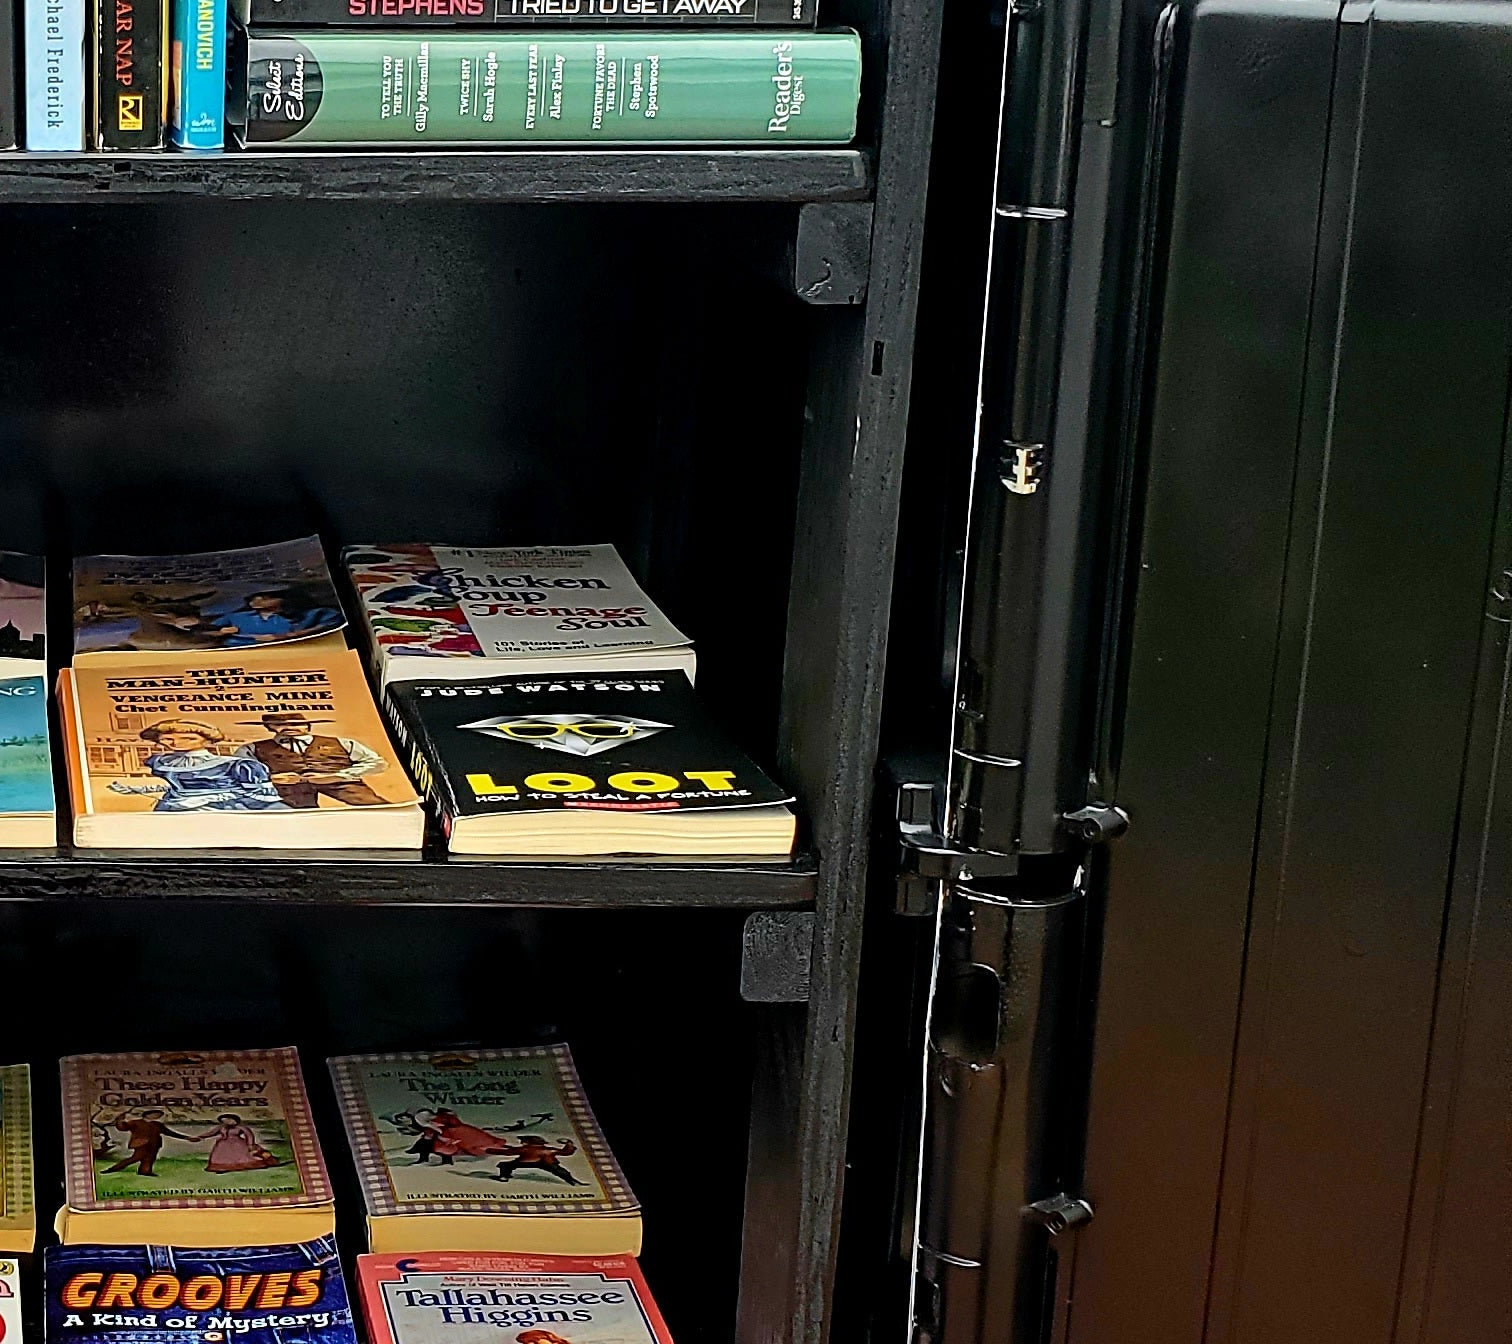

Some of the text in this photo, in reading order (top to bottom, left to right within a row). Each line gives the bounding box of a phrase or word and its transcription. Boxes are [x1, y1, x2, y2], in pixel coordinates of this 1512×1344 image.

[115, 37, 132, 87] NAP
[46, 49, 64, 129] Frederick
[262, 60, 283, 114] Select
[285, 52, 305, 122] Editions
[767, 41, 793, 134] Reader's
[789, 74, 806, 115] Digest
[468, 603, 649, 620] Teenage
[555, 616, 652, 631] Soul
[106, 672, 329, 689] MAN-HUNTER
[185, 667, 245, 678] THE
[109, 690, 334, 704] VENGEANCE MINE
[420, 686, 504, 697] JUDE
[515, 682, 662, 694] WATSON
[115, 702, 335, 714] Chet Cunningham
[464, 770, 737, 795] LOOT
[475, 789, 753, 804] HOW TO STEAL A FORTUNE
[93, 1076, 269, 1094] These Happy
[60, 1268, 323, 1312] GROOVES
[395, 1288, 626, 1307] Tallahassee
[62, 1312, 332, 1334] A Kind of Mystery
[438, 1307, 594, 1329] Higgins
